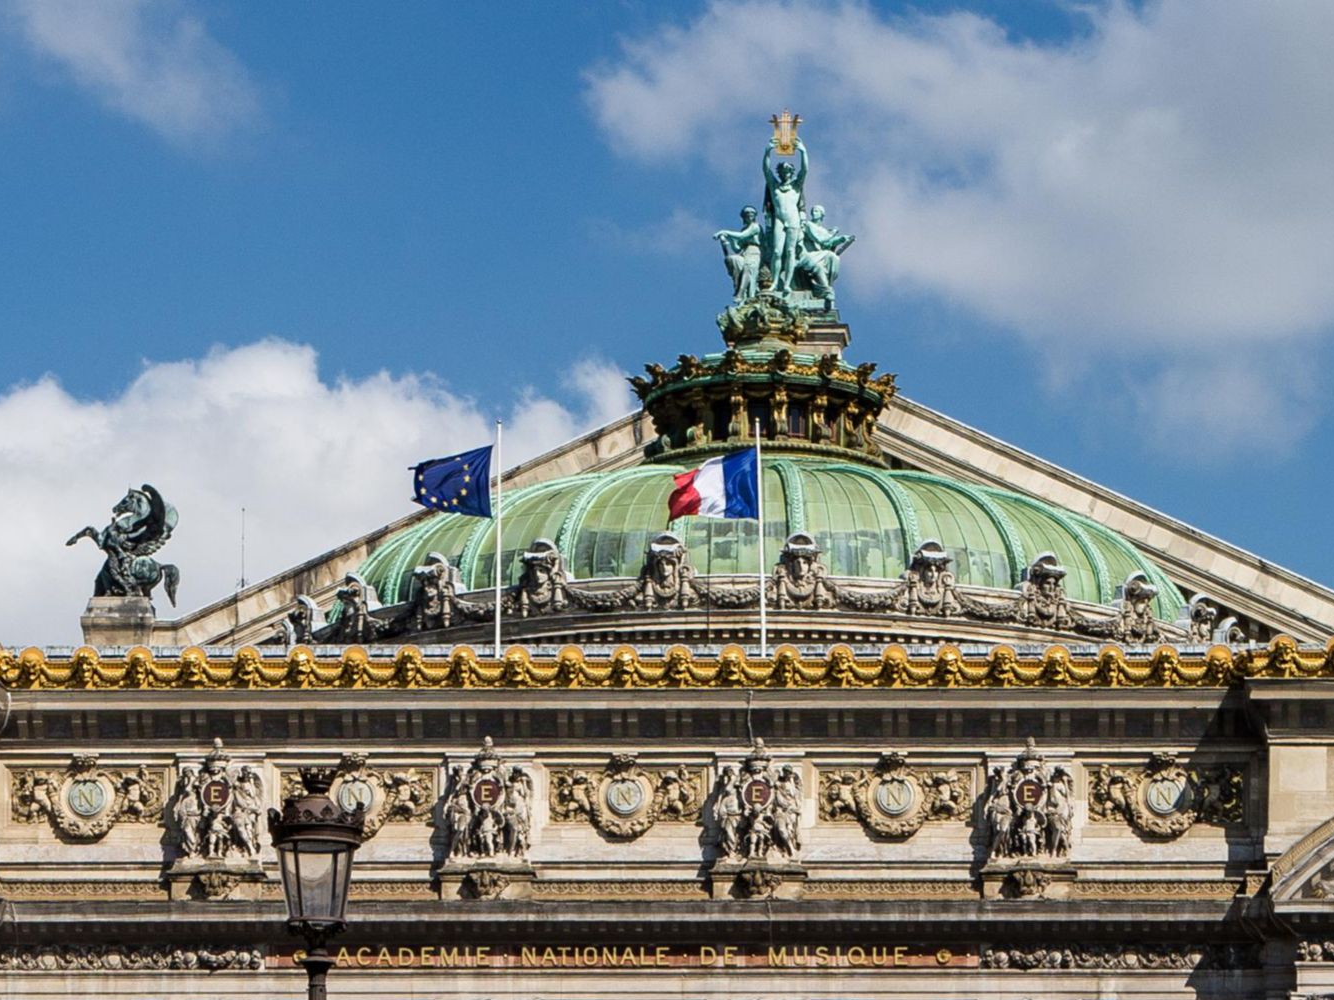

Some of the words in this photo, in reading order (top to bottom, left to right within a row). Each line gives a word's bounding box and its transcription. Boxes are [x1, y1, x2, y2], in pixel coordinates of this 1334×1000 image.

[78, 789, 93, 807] N
[210, 786, 222, 802] E
[347, 788, 362, 806] N
[481, 785, 493, 801] E
[616, 787, 631, 806] N
[752, 786, 763, 802] E
[886, 787, 902, 806] N
[1023, 786, 1035, 802] E
[1156, 787, 1171, 806] N
[337, 947, 491, 966] ACADEMIE
[521, 947, 670, 966] NATIONALE
[700, 947, 738, 966] DE
[768, 947, 909, 967] MUSIQUE
